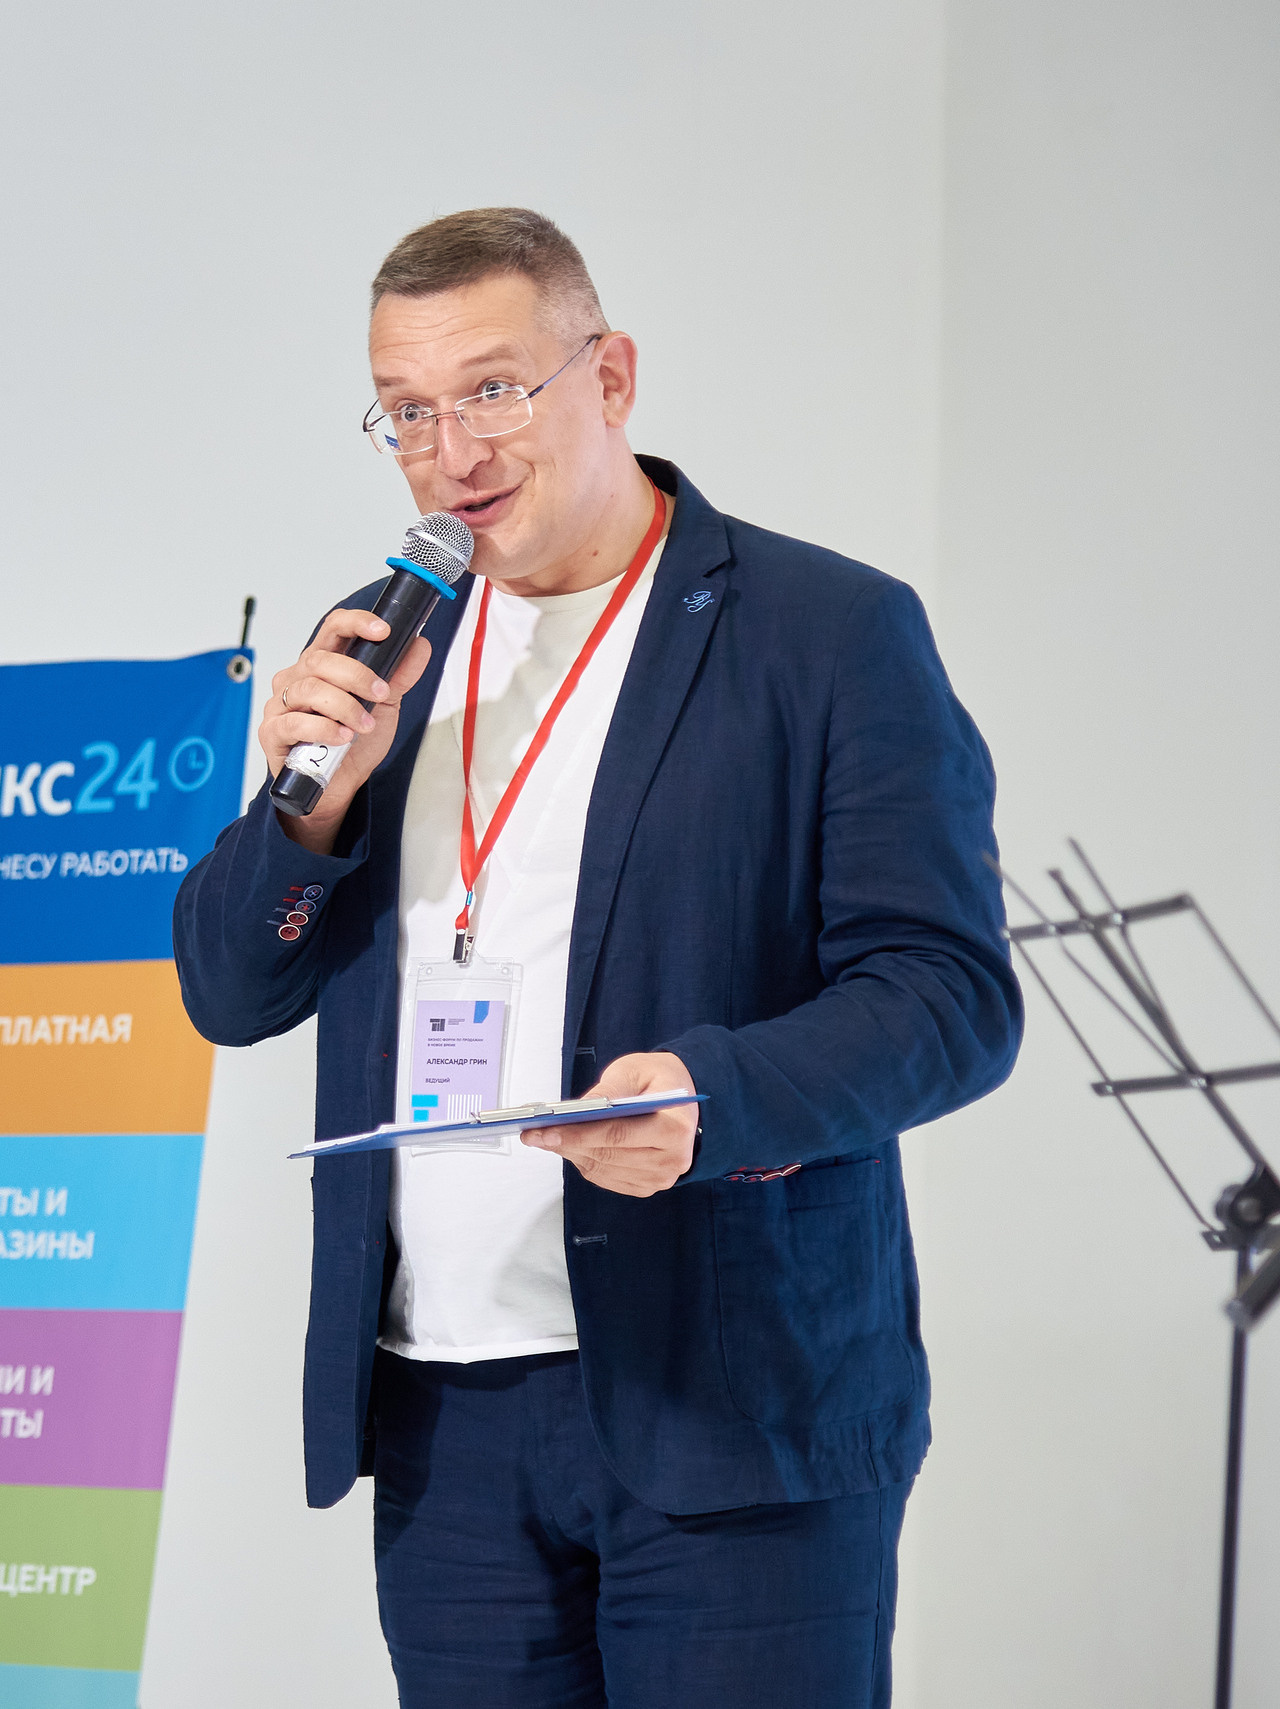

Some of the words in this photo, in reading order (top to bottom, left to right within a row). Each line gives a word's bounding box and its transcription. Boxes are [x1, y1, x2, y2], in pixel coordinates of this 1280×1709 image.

[310, 745, 328, 767] 2
[60, 847, 188, 877] РАБОТАТЬ
[426, 1058, 468, 1066] АЛЕКСАНДР
[44, 1187, 68, 1216] И
[30, 1365, 55, 1396] И
